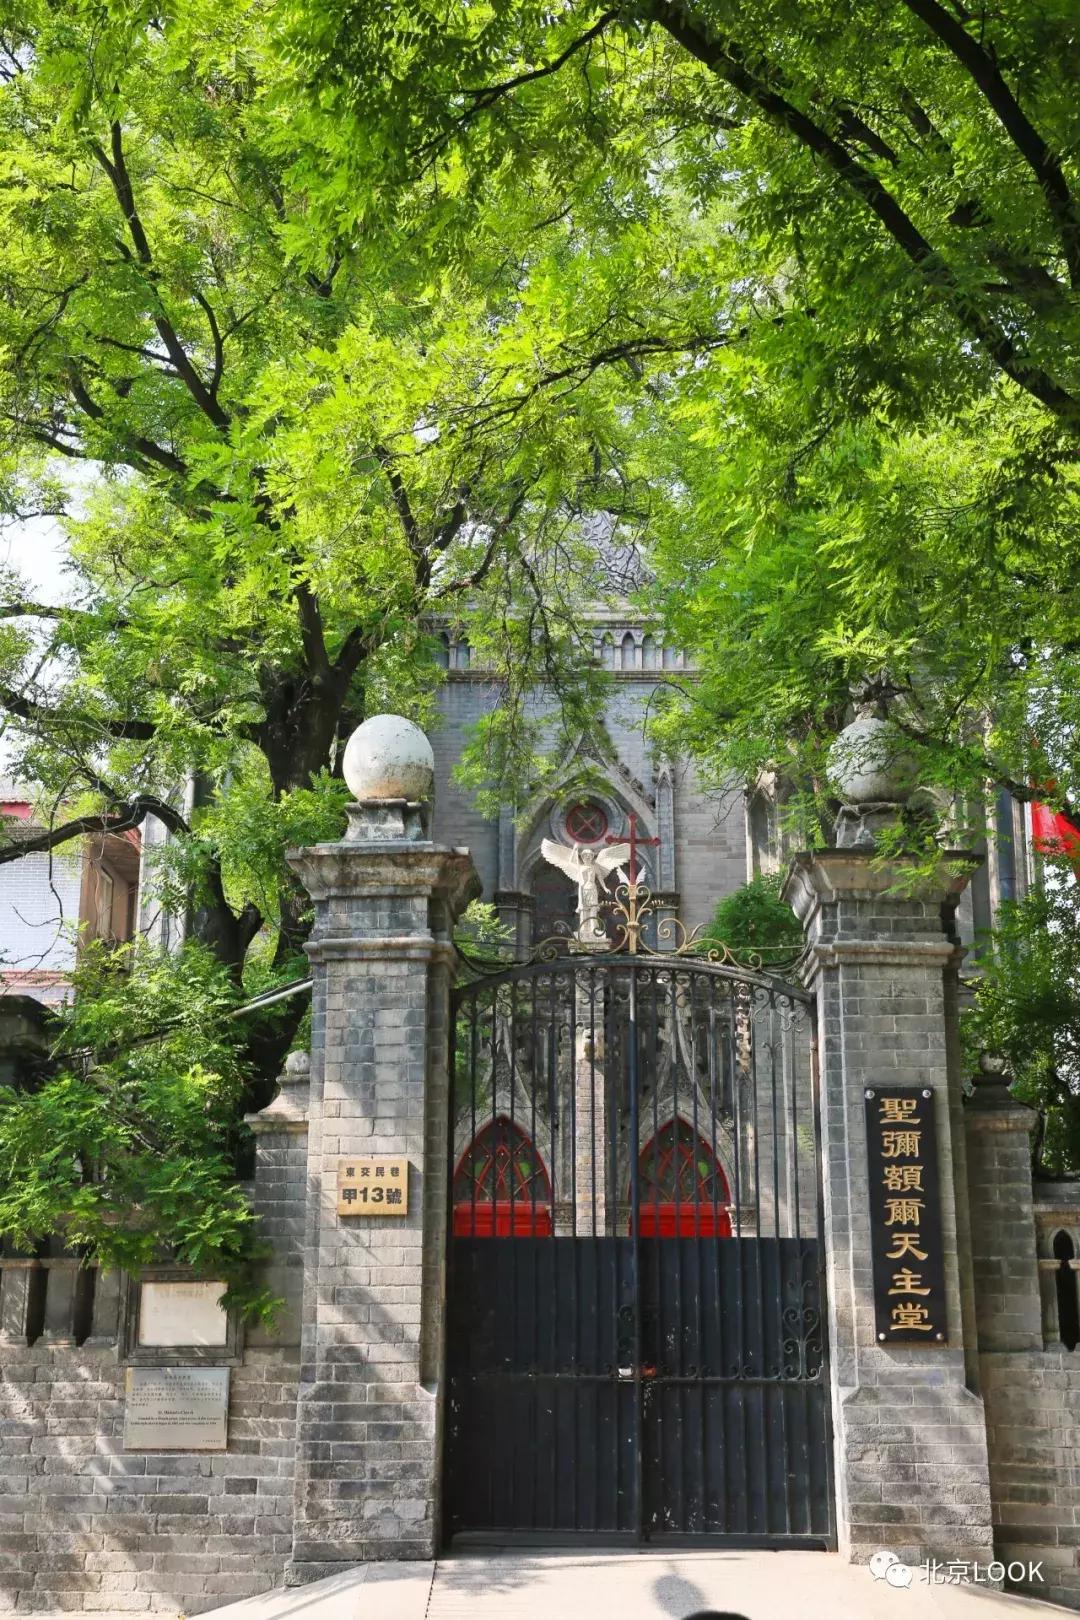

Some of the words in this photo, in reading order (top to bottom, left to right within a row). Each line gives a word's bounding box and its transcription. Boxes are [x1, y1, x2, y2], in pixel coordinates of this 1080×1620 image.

[346, 1167, 400, 1178] 東交民巷
[342, 1187, 402, 1205] 甲13號
[879, 1097, 934, 1331] 聖彌額爾天主堂
